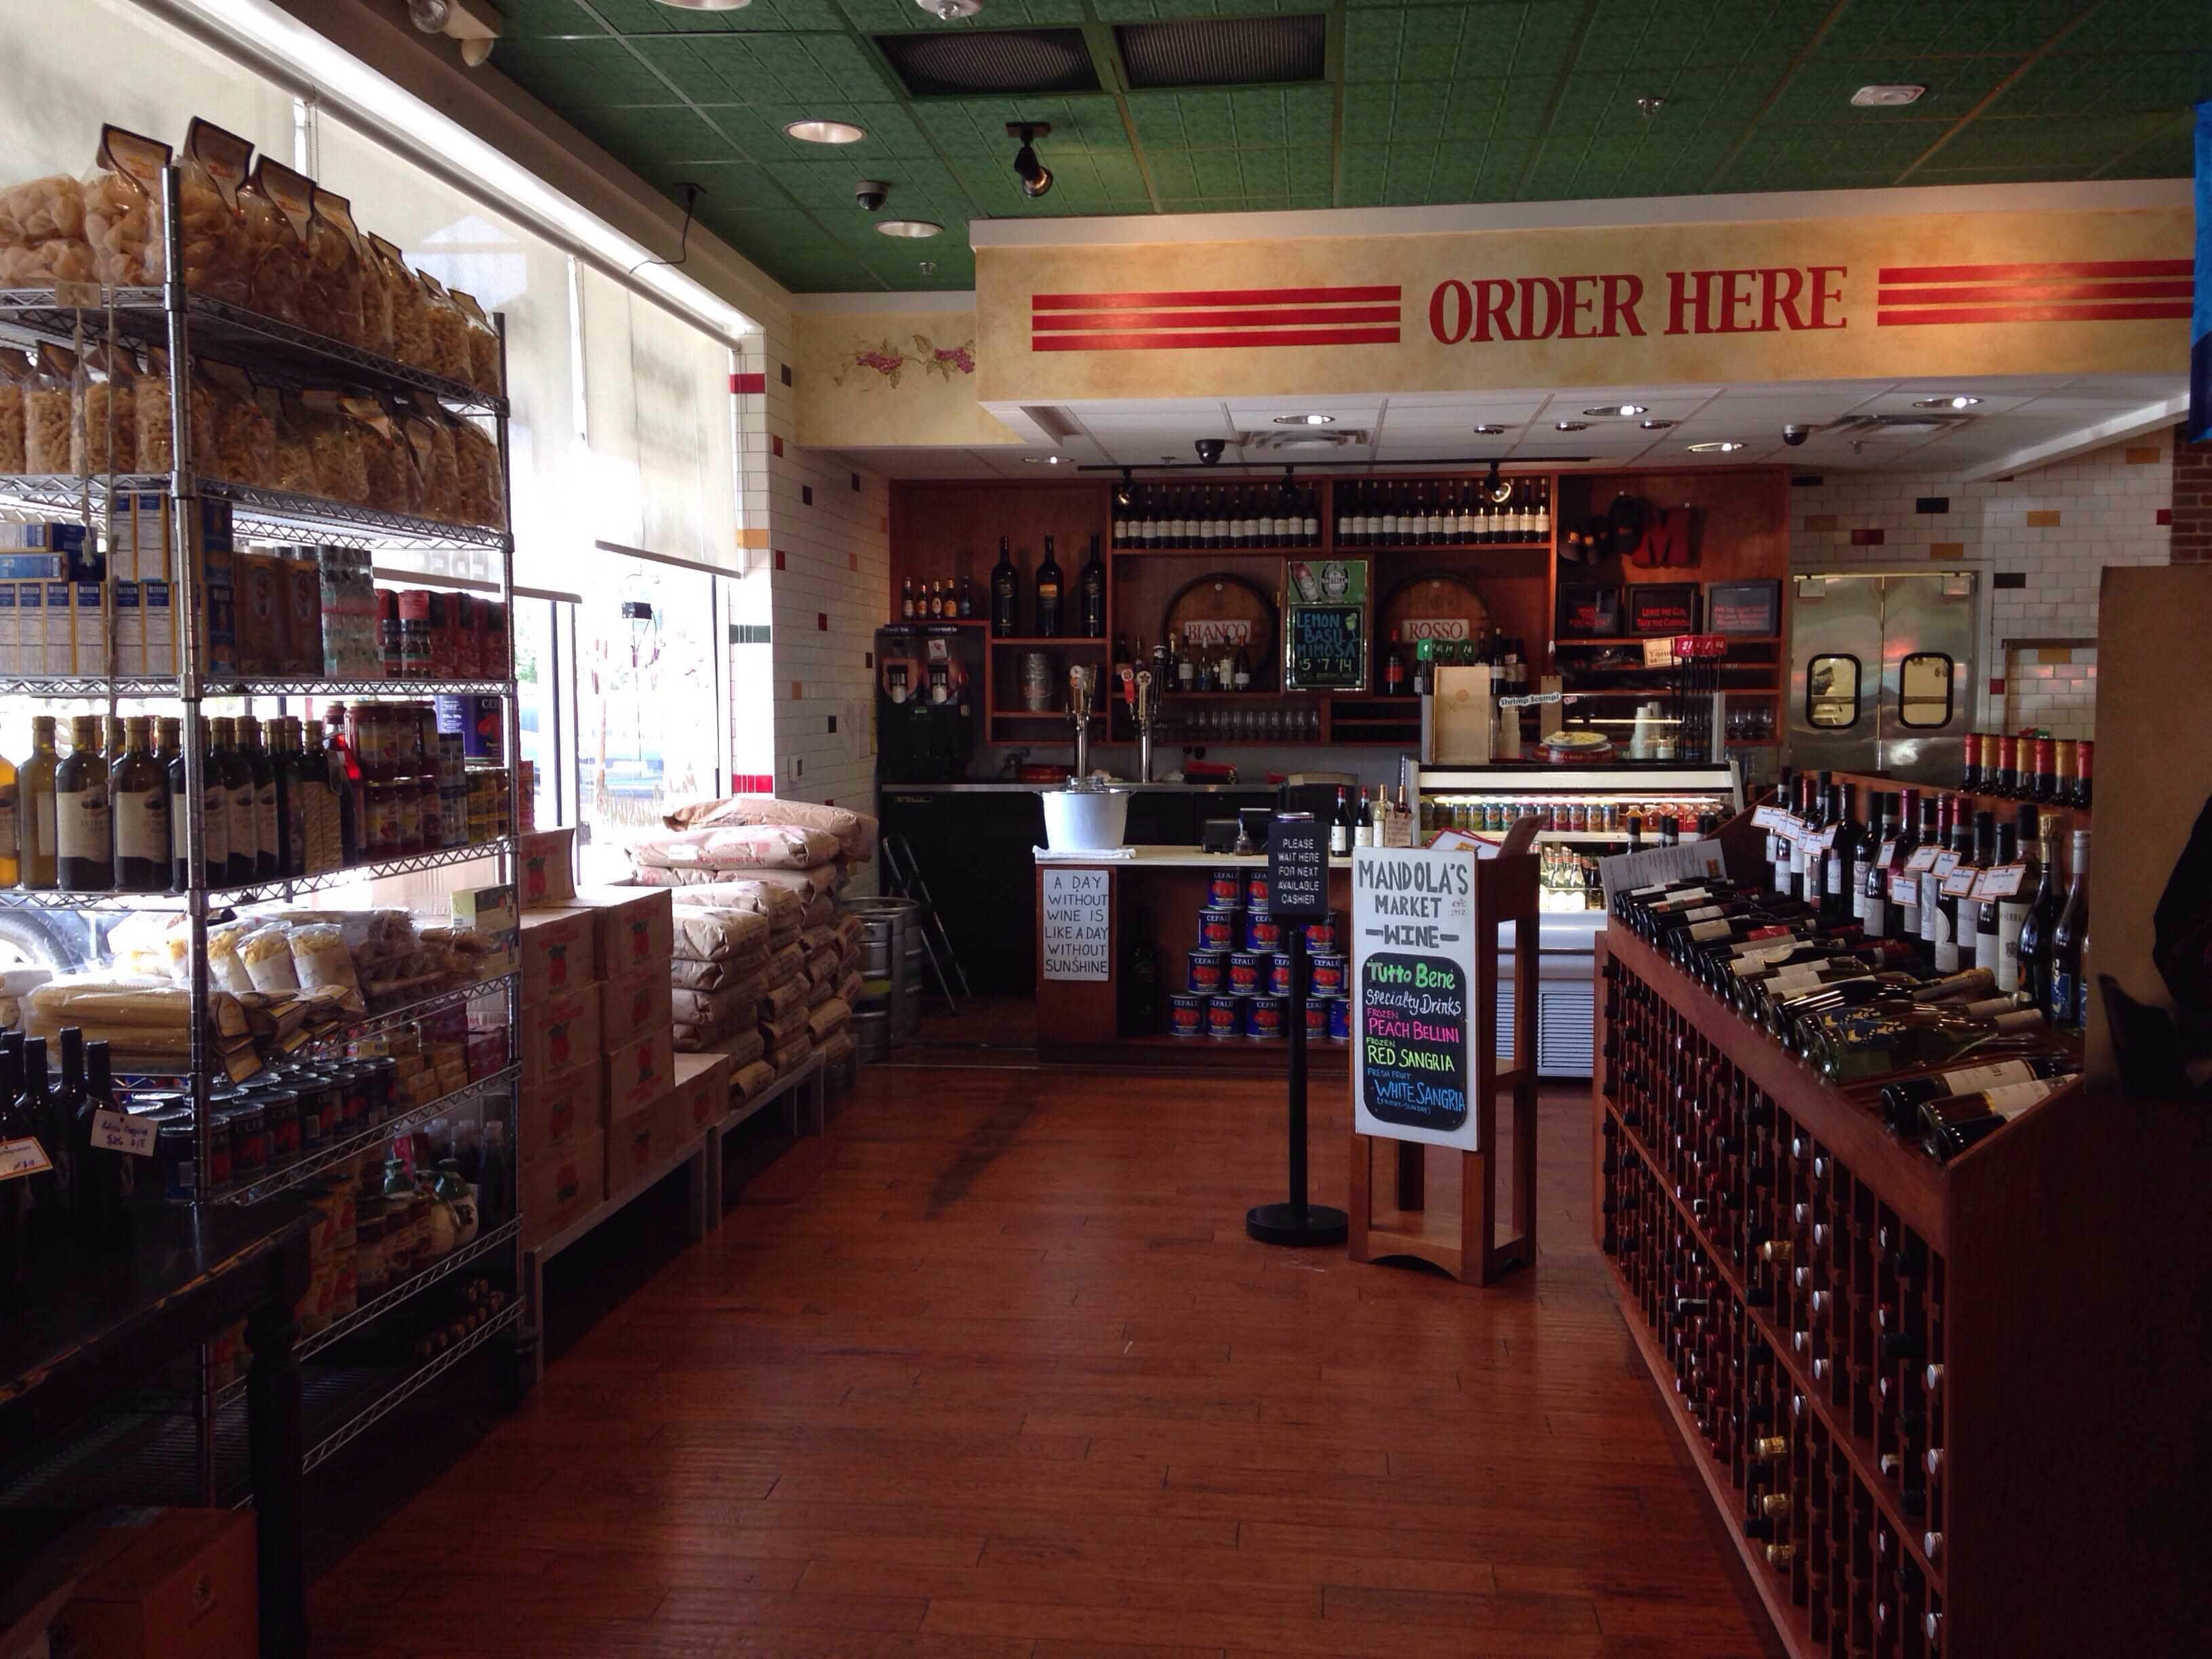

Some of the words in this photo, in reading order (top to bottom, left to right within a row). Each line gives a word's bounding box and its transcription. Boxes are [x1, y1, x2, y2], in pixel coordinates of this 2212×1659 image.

[1429, 274, 1647, 344] ORDER
[1664, 266, 1847, 335] HERE
[1296, 612, 1340, 628] LEMON
[1188, 623, 1248, 640] BIANCO
[1304, 629, 1346, 645] BASIL
[1409, 622, 1462, 639] ROSSO
[1296, 643, 1356, 658] MIMOSA
[1283, 838, 1314, 849] PLEASE
[1277, 852, 1296, 862] WAIT
[1298, 852, 1320, 863] HERE
[1278, 866, 1295, 876] FOR
[1297, 867, 1319, 877] NEXT
[1358, 860, 1469, 895] MANDOLA'S
[1054, 876, 1062, 889] A
[1073, 876, 1101, 889] DAY
[1277, 880, 1320, 891] AVAILABLE
[1048, 894, 1108, 906] WITHOUT
[1281, 894, 1315, 904] CASHIER
[1375, 895, 1442, 918] MARKET
[1047, 910, 1081, 922] WINE
[1090, 909, 1104, 922] IS
[1045, 926, 1072, 939] LIKE
[1076, 926, 1083, 939] A
[1086, 926, 1109, 940] DAY
[1048, 944, 1106, 956] WITHOUT
[1045, 959, 1108, 974] SUNSHINE
[1366, 961, 1412, 983] Tutto
[1365, 989, 1419, 1016] Specialty
[1420, 994, 1461, 1016] Drinks
[1366, 1008, 1399, 1019] FROZEN
[1369, 1018, 1410, 1038] PEACH
[1413, 1021, 1459, 1043] BELLINI
[1366, 1037, 1396, 1047] FROZEN
[1368, 1045, 1396, 1066] RED
[1399, 1048, 1456, 1072] SANGRIA
[1368, 1067, 1390, 1078] FRESH
[1374, 1079, 1415, 1103] WHITE
[1416, 1082, 1465, 1111] SANGRIA
